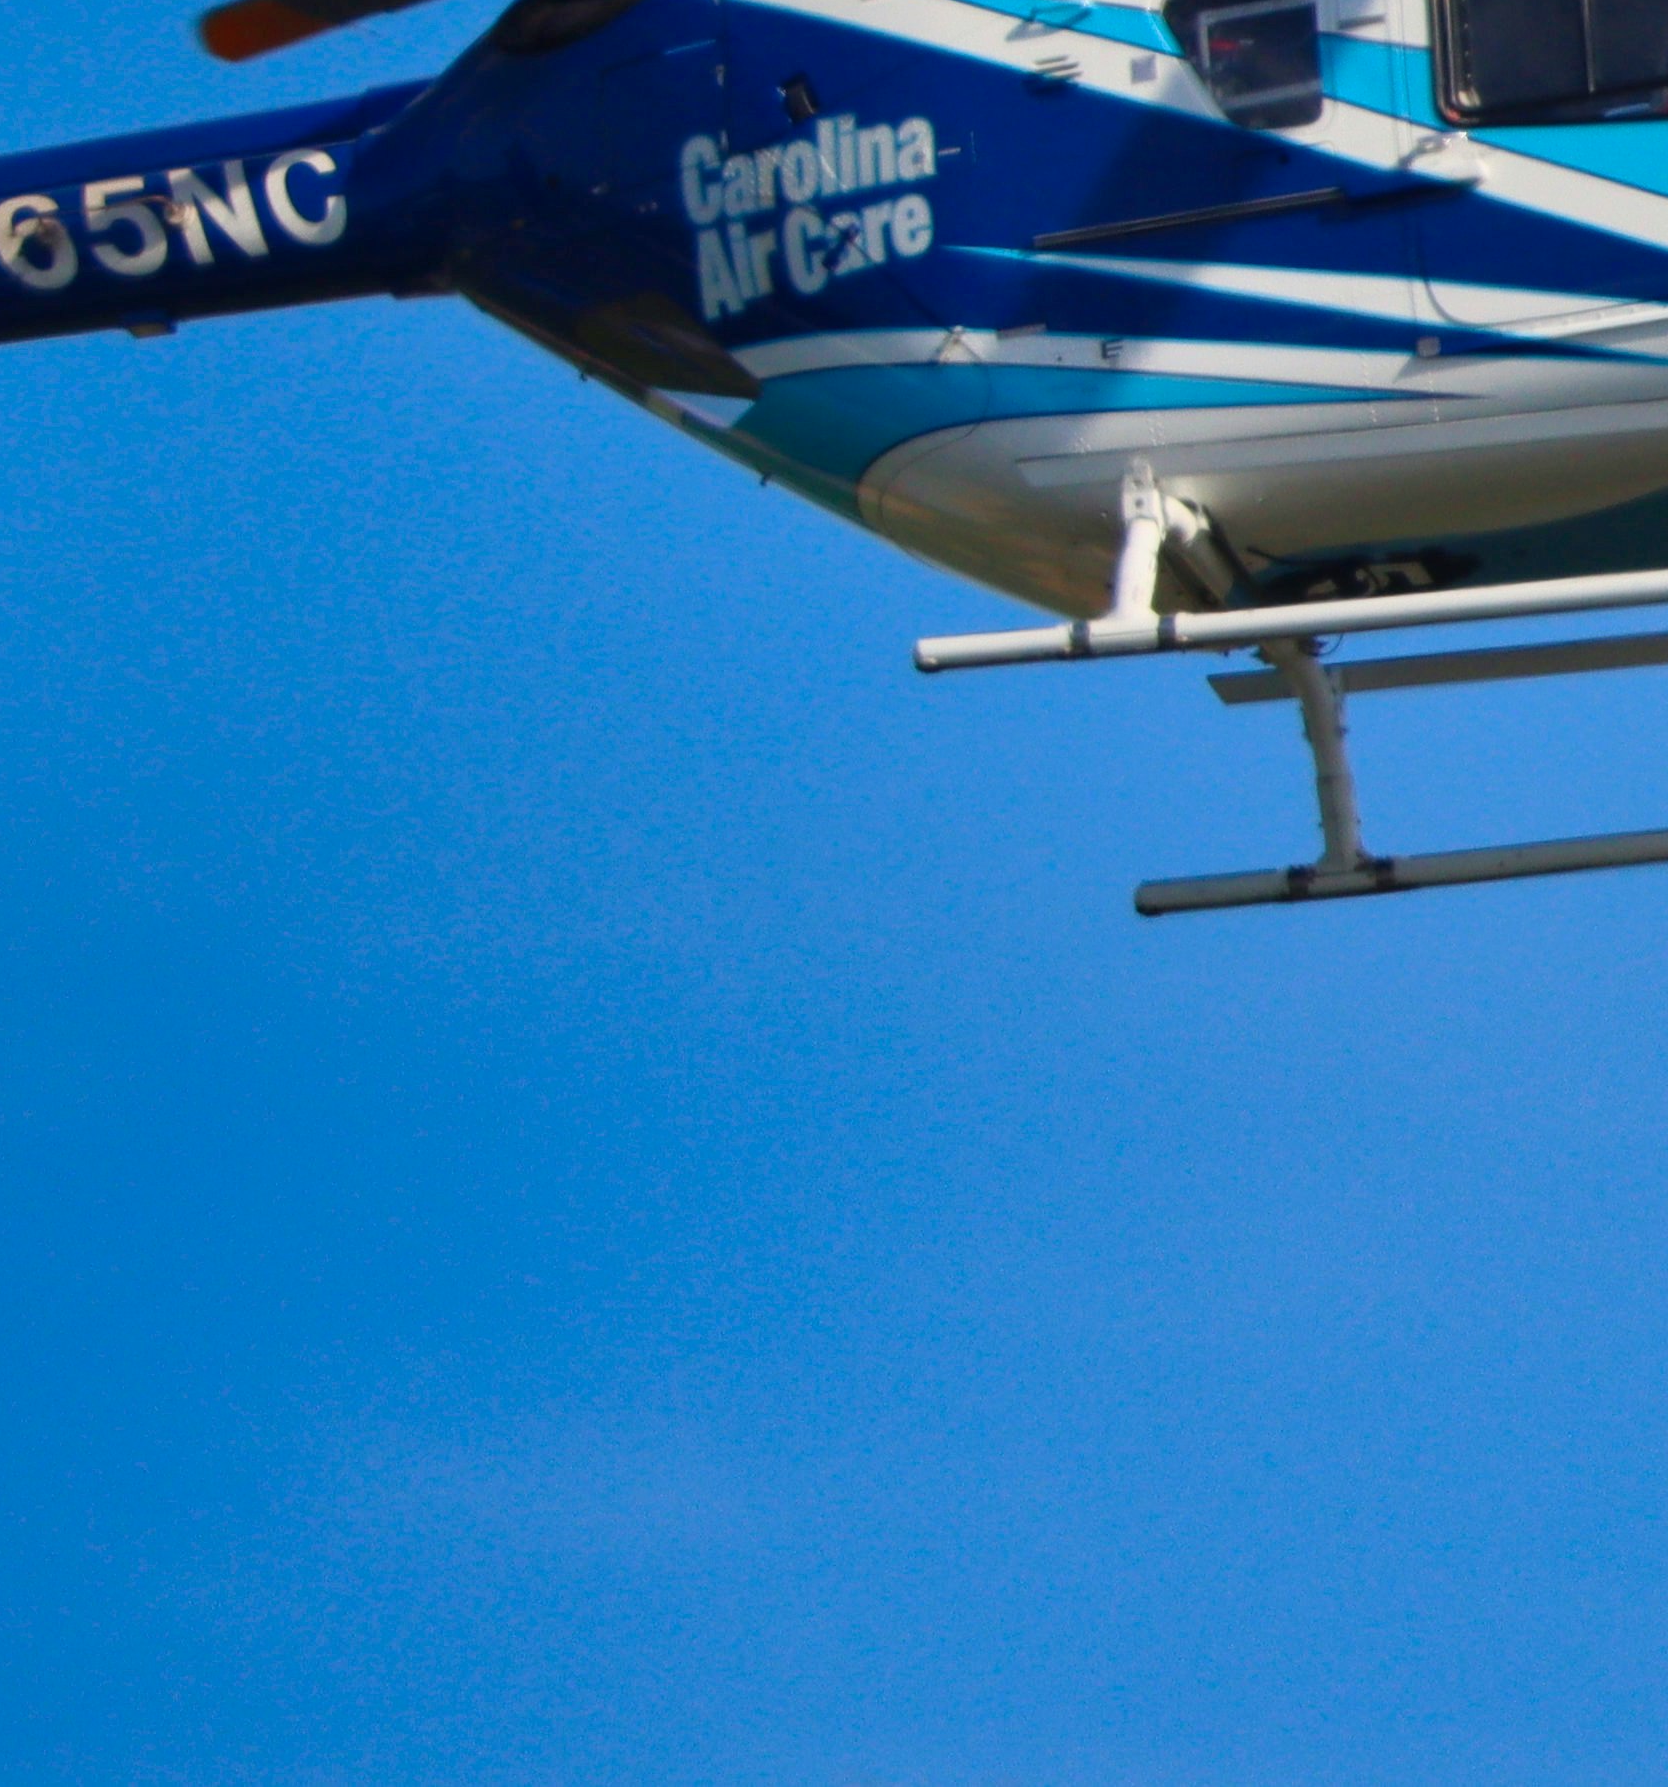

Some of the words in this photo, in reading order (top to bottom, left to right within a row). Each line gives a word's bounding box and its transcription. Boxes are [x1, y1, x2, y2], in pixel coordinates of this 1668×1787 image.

[682, 113, 936, 224] Carolina
[698, 222, 777, 322] Air
[784, 193, 933, 294] Care
